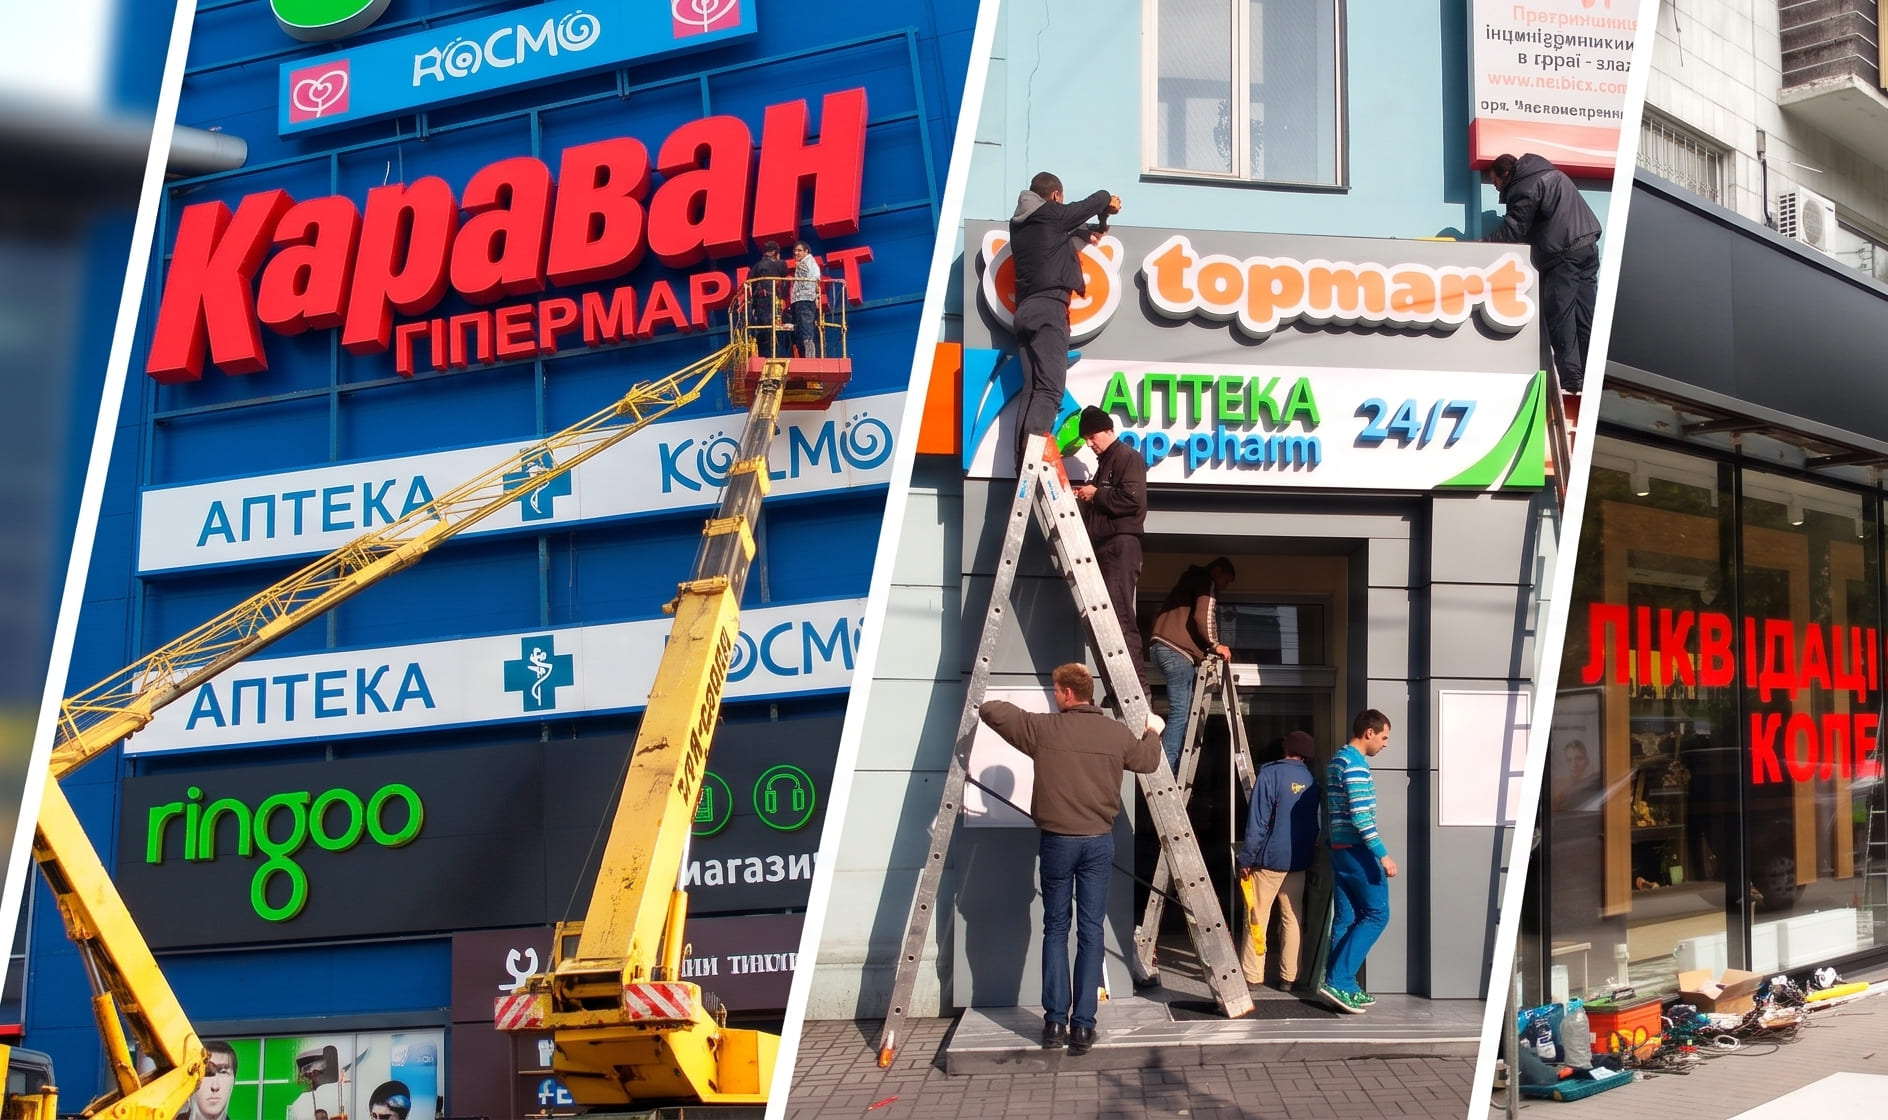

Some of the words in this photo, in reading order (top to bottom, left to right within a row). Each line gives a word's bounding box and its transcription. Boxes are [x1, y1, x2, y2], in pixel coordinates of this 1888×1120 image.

[395, 246, 874, 378] ГІПЕРМАРТ
[1151, 241, 1529, 325] topmart
[1102, 371, 1322, 427] АПТЕКА
[1357, 397, 1478, 444] 24/7
[196, 475, 442, 547] АПТЕКА
[185, 662, 436, 731] АПТЕКА
[147, 782, 424, 922] ringoo
